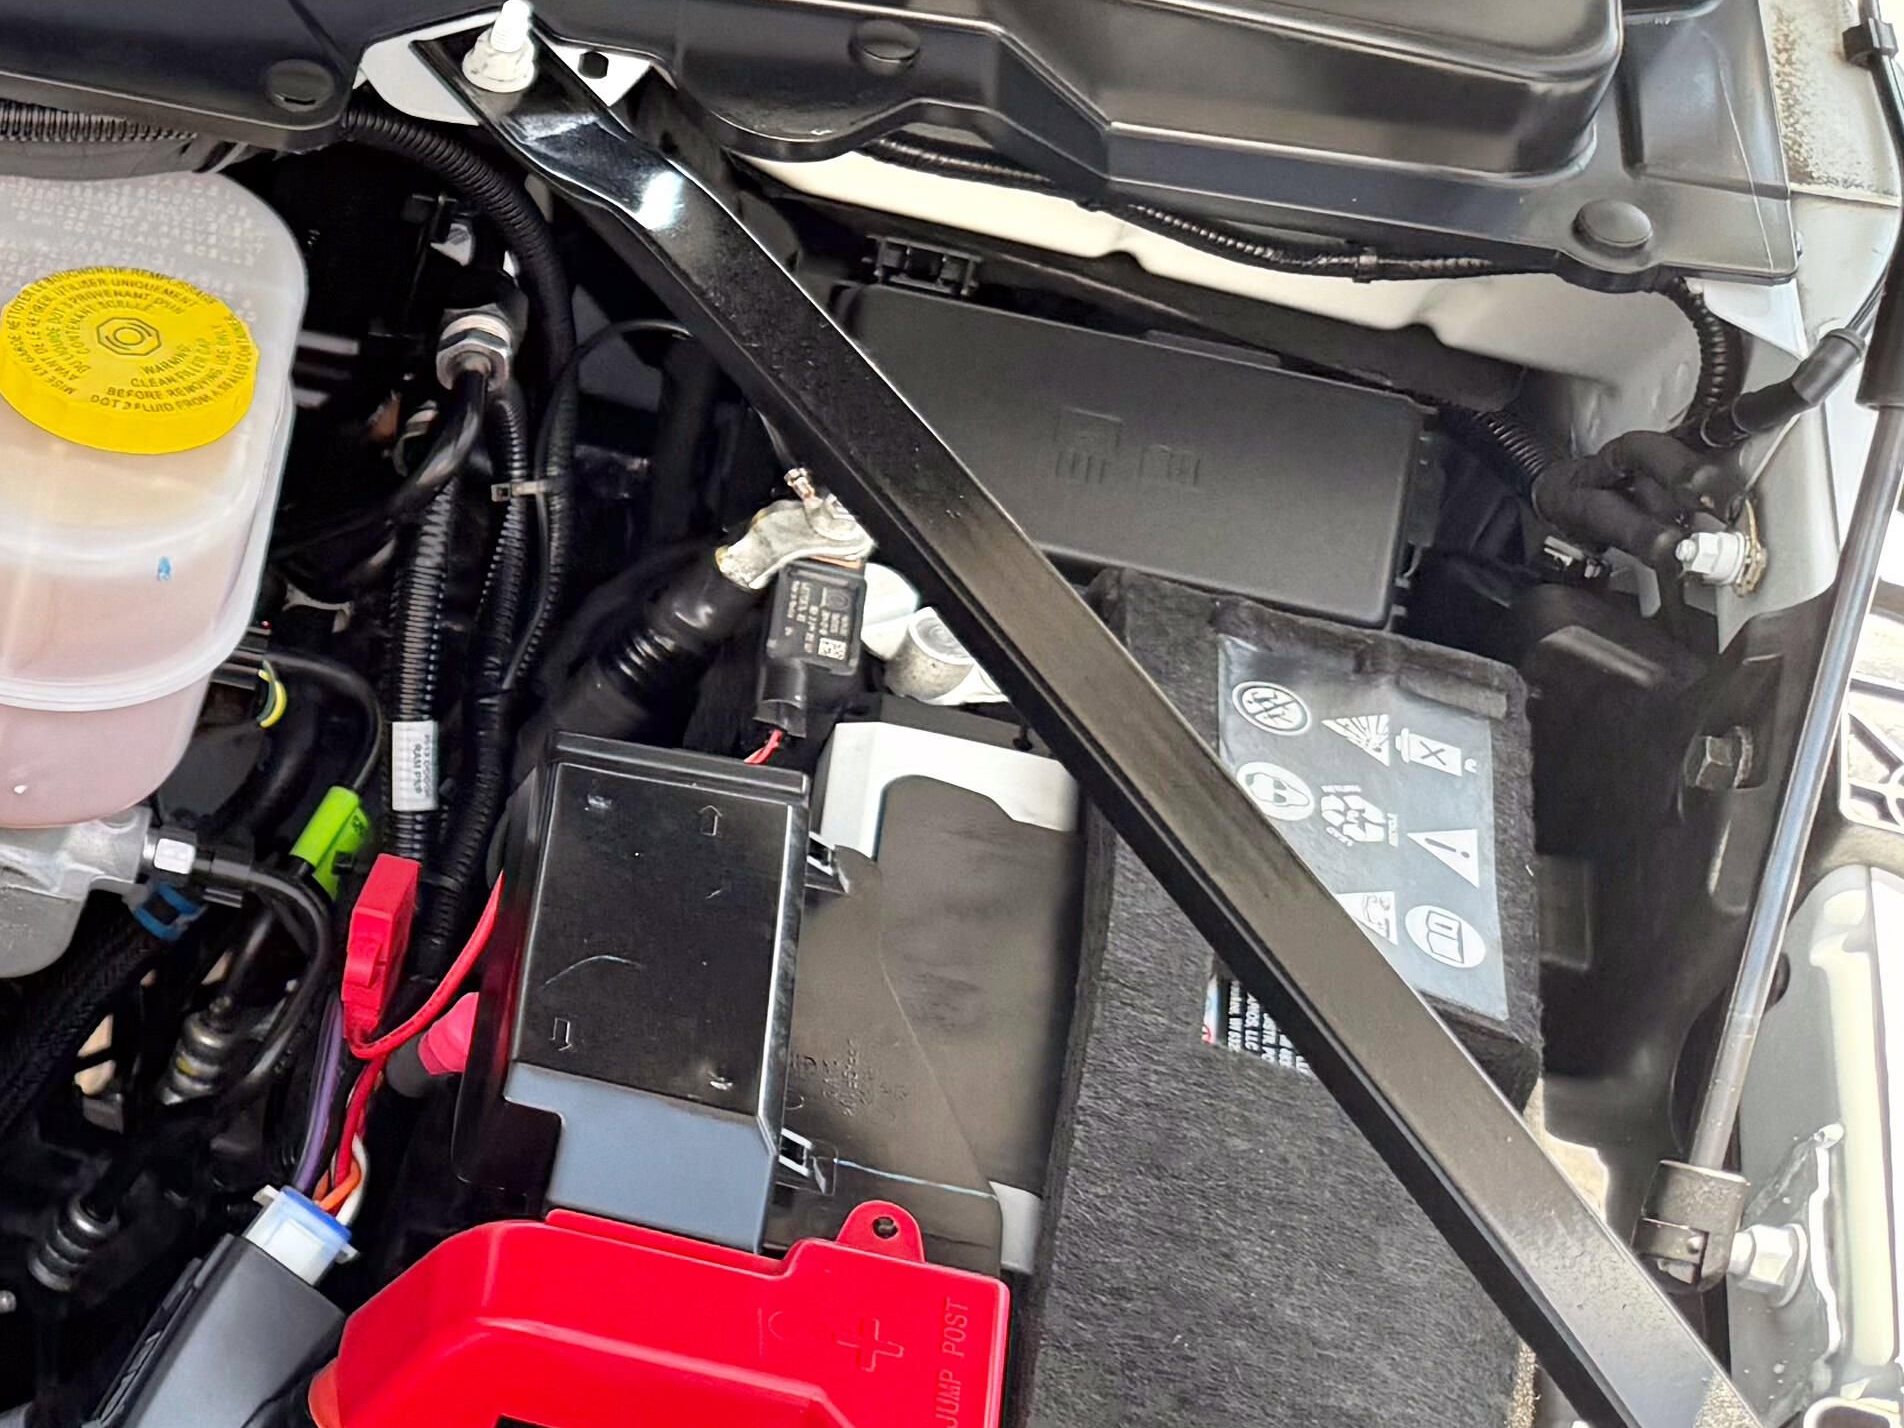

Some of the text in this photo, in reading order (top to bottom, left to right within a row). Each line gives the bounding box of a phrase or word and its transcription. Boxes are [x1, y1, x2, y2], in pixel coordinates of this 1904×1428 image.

[140, 344, 191, 375] WARNING
[130, 373, 176, 388] CLEAN
[89, 393, 122, 408] DOT
[133, 401, 176, 414] FLUID
[106, 386, 164, 401] BEFORE
[942, 1297, 972, 1360] POST
